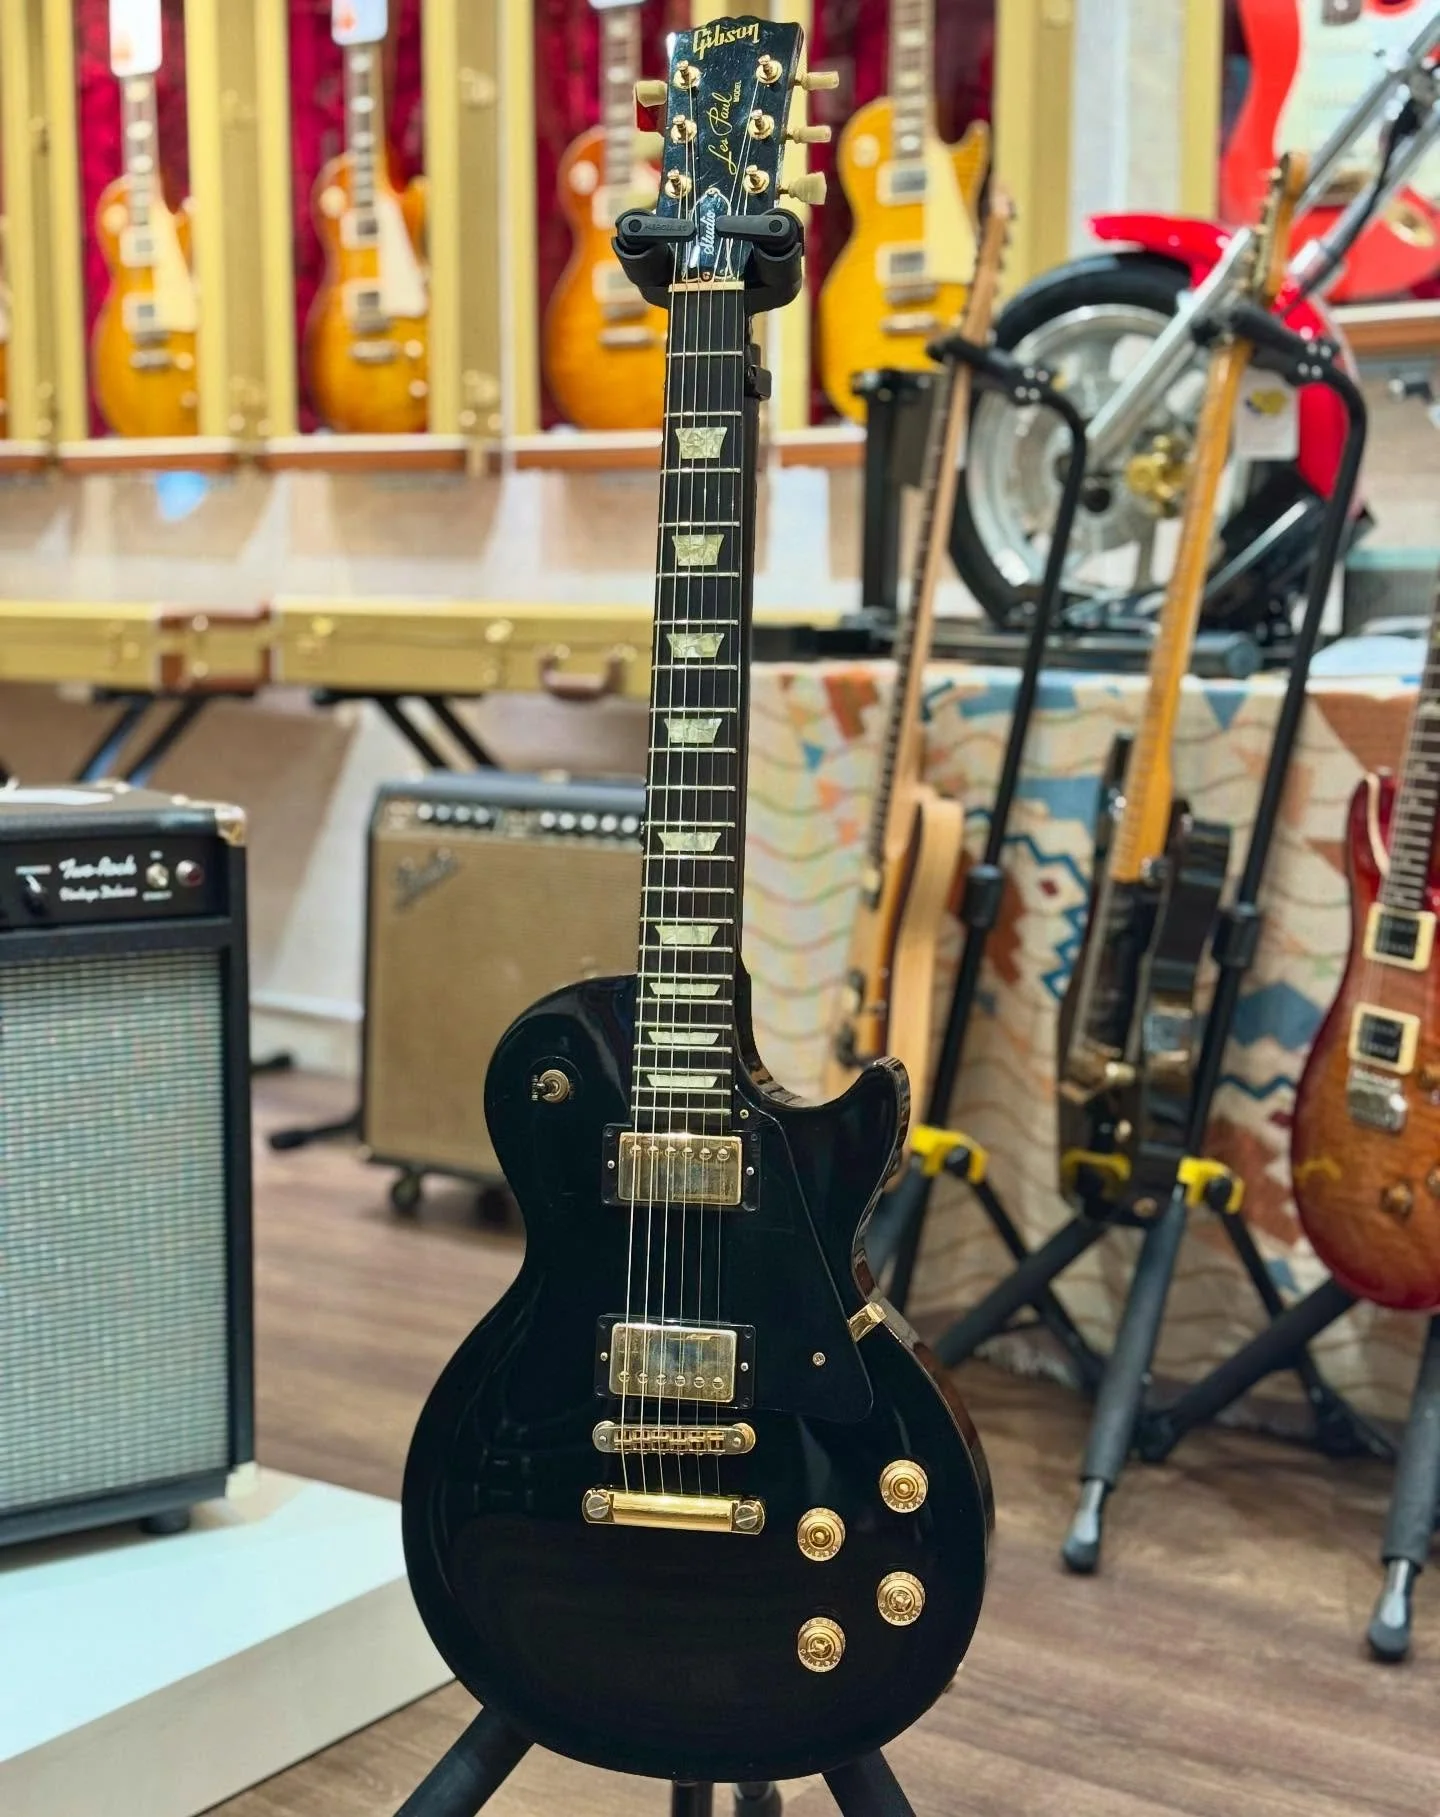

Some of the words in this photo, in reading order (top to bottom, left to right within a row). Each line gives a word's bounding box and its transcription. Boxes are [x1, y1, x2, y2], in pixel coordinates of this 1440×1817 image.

[693, 23, 761, 60] Gibson
[706, 92, 733, 136] Paul
[708, 138, 737, 175] Les
[699, 210, 716, 255] Studio
